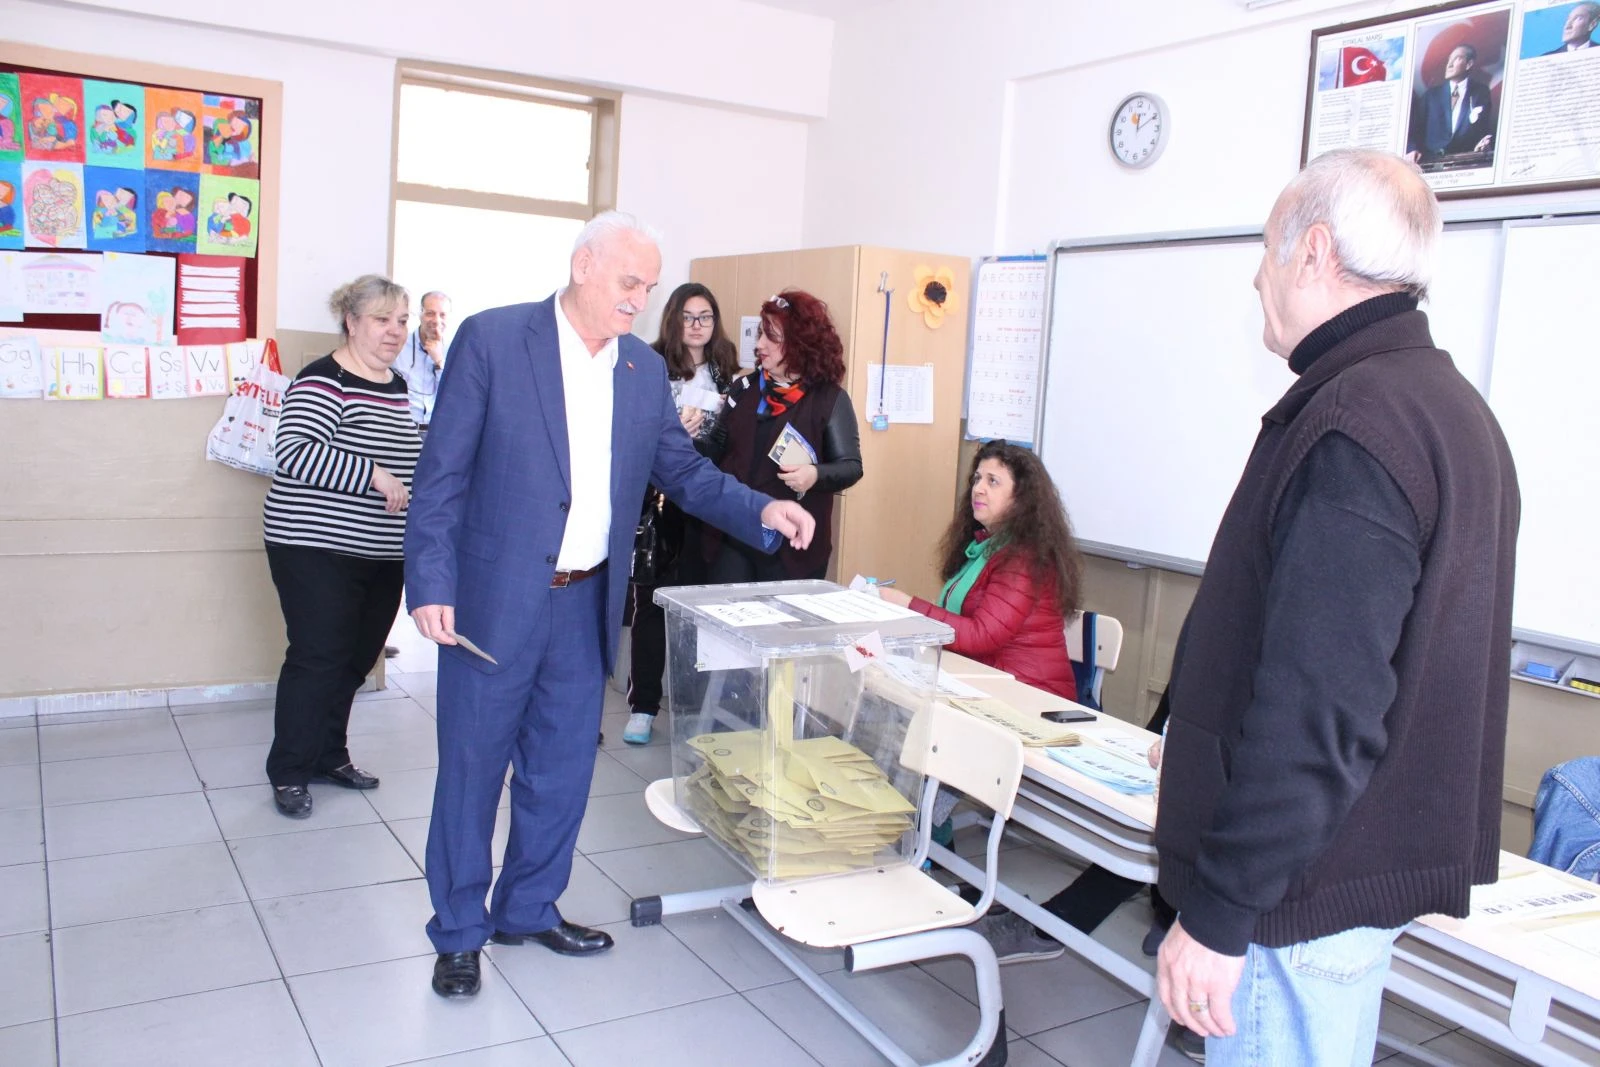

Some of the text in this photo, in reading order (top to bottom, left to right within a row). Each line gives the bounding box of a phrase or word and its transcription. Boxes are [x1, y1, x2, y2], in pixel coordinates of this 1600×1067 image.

[62, 351, 95, 376] Hh
[109, 350, 144, 374] Cc
[190, 351, 220, 372] Vv
